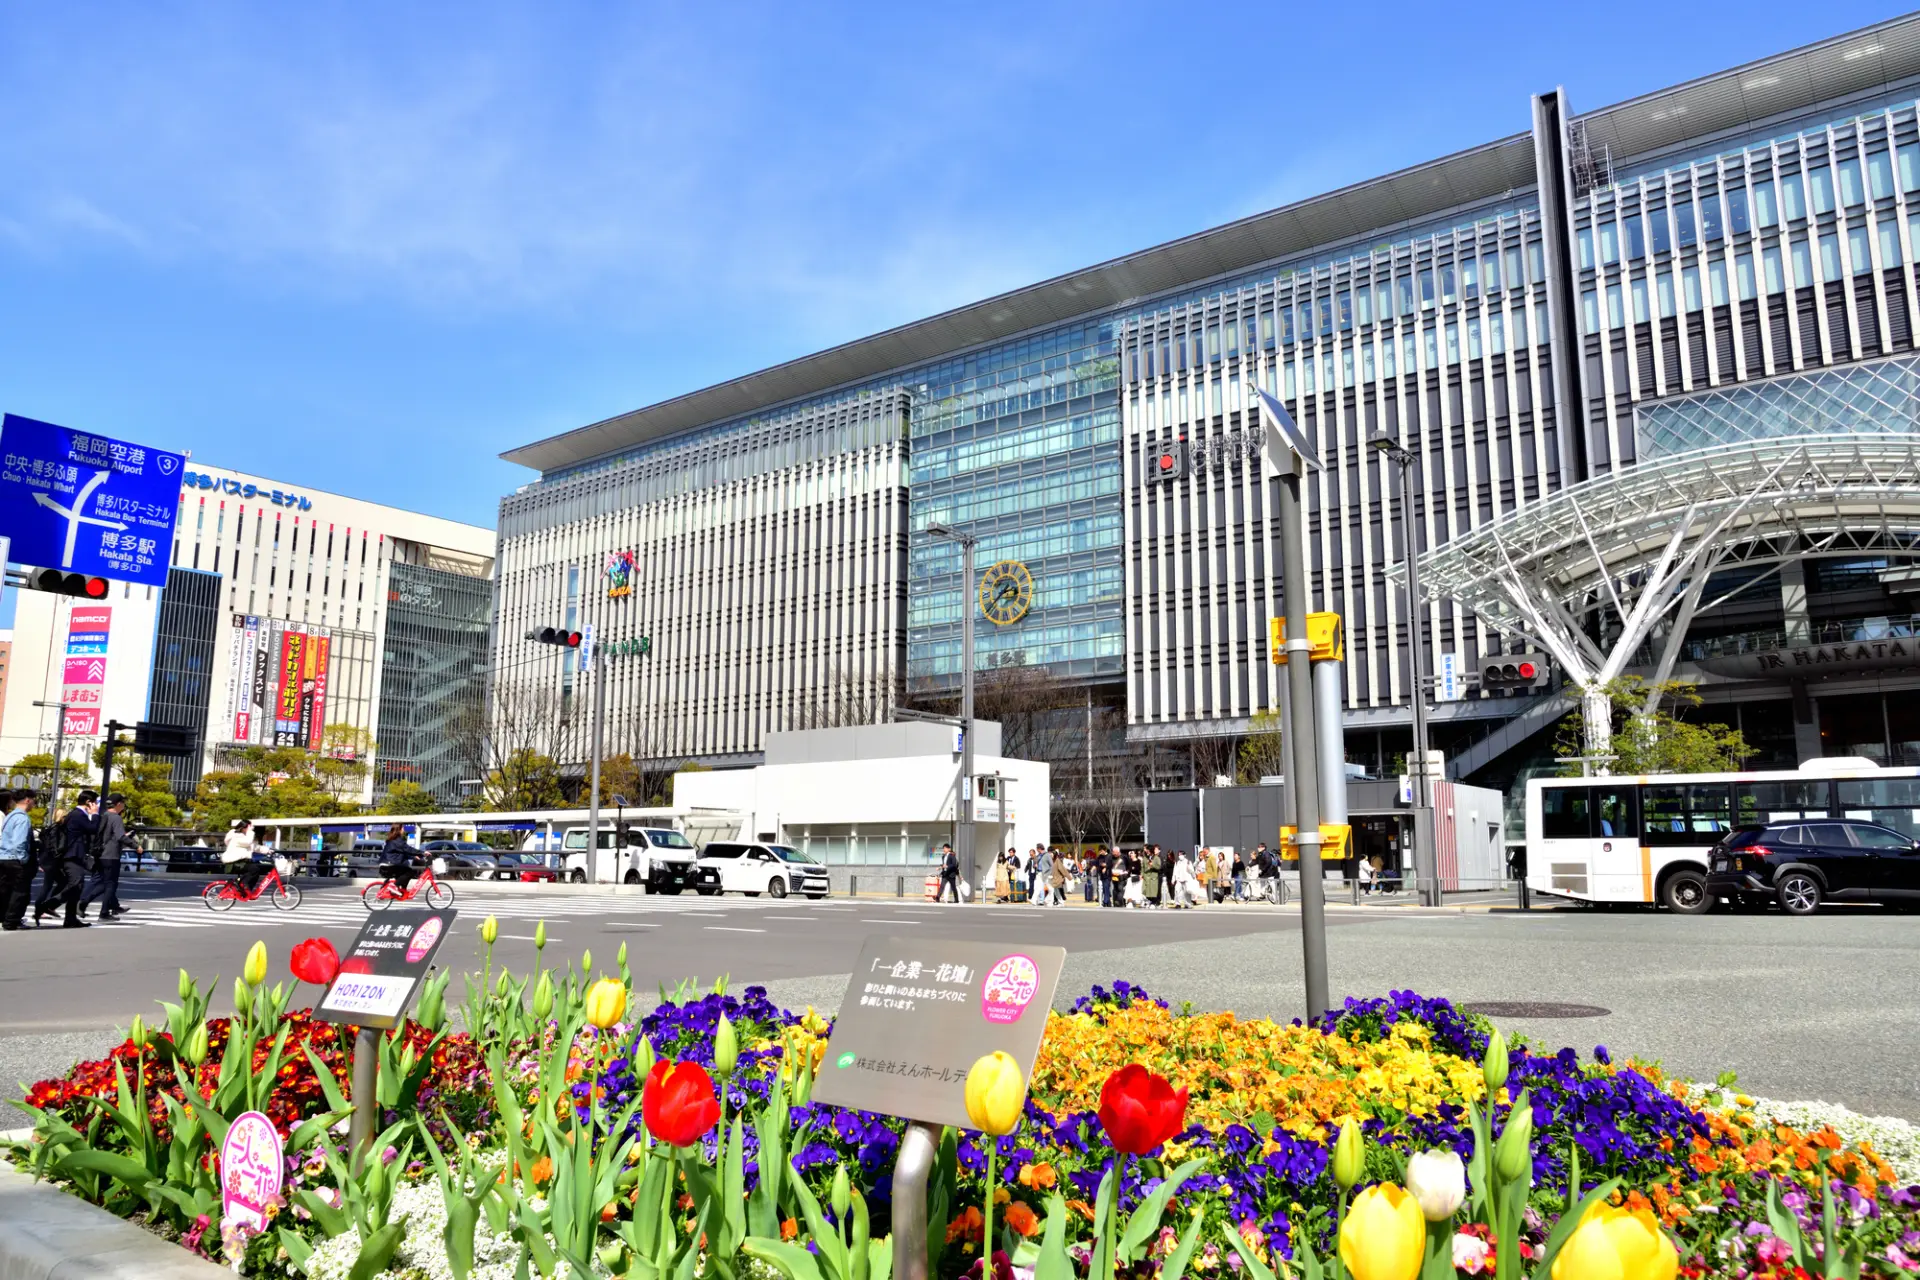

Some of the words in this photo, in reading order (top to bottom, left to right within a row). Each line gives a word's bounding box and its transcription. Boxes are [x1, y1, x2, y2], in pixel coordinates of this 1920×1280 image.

[72, 434, 146, 465] 福岡空港
[4, 453, 78, 484] 中央・博多ふ頭
[68, 450, 108, 468] Fukuoka
[112, 460, 142, 476] Airport
[163, 459, 172, 470] 3
[2, 471, 21, 483] Chuo
[26, 477, 52, 490] Hakata
[54, 482, 74, 494] Wharf
[183, 471, 312, 512] 博多バスターミナル
[96, 493, 170, 520] 博多バスターミナル
[95, 508, 120, 520] Hakata
[122, 512, 136, 522] Bus
[138, 515, 169, 529] Terminal
[101, 531, 156, 556] 博多駅
[100, 548, 132, 562] Hakata
[136, 552, 154, 566] Sta.
[609, 586, 632, 598] PLAZA
[72, 616, 108, 624] namco
[1757, 654, 1785, 670] JR
[1791, 641, 1907, 666] HAKATA
[63, 689, 100, 702] しまむら
[64, 716, 94, 732] Avail
[278, 732, 295, 742] 24
[870, 958, 974, 985] 「一企業一花壇」
[335, 984, 386, 1000] HORIZON
